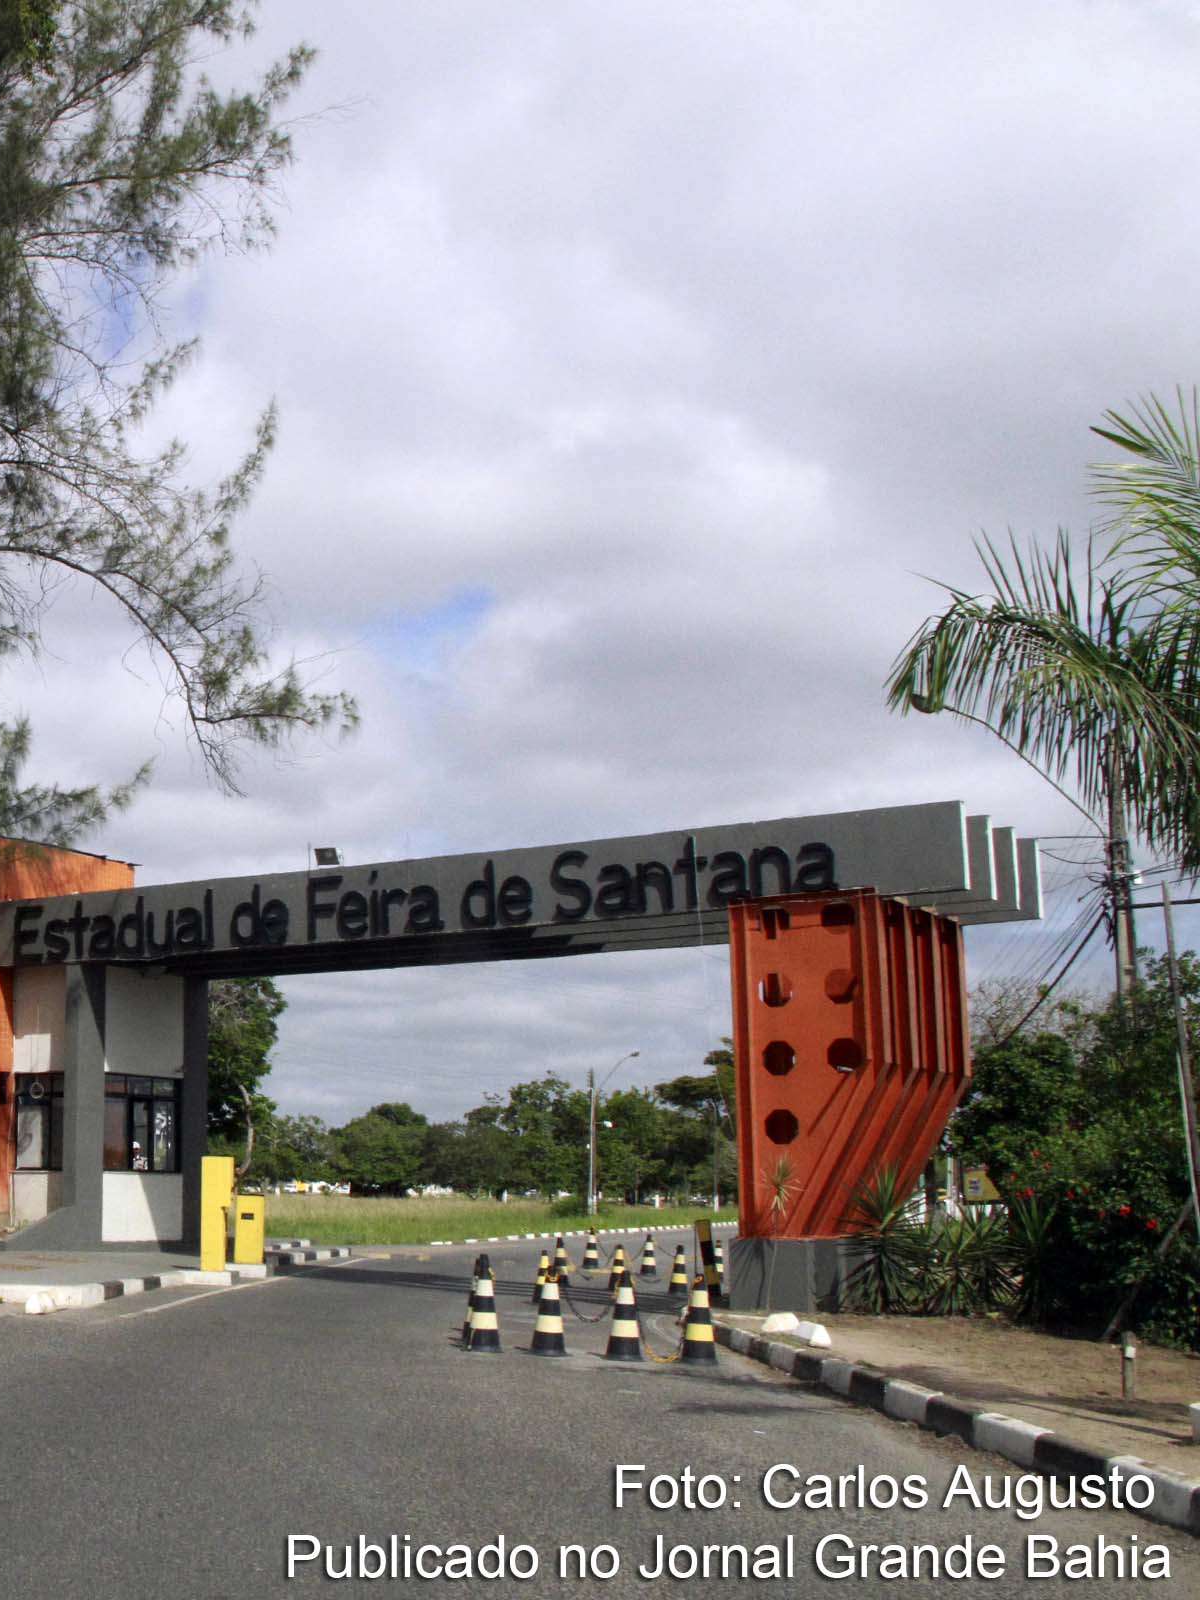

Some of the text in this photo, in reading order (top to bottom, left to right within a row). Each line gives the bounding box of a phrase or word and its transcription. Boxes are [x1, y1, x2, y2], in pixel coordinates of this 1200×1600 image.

[11, 887, 214, 964] Estadual
[230, 883, 289, 946] de
[306, 870, 445, 941] Feira
[460, 859, 533, 929] de
[549, 836, 839, 922] Santana
